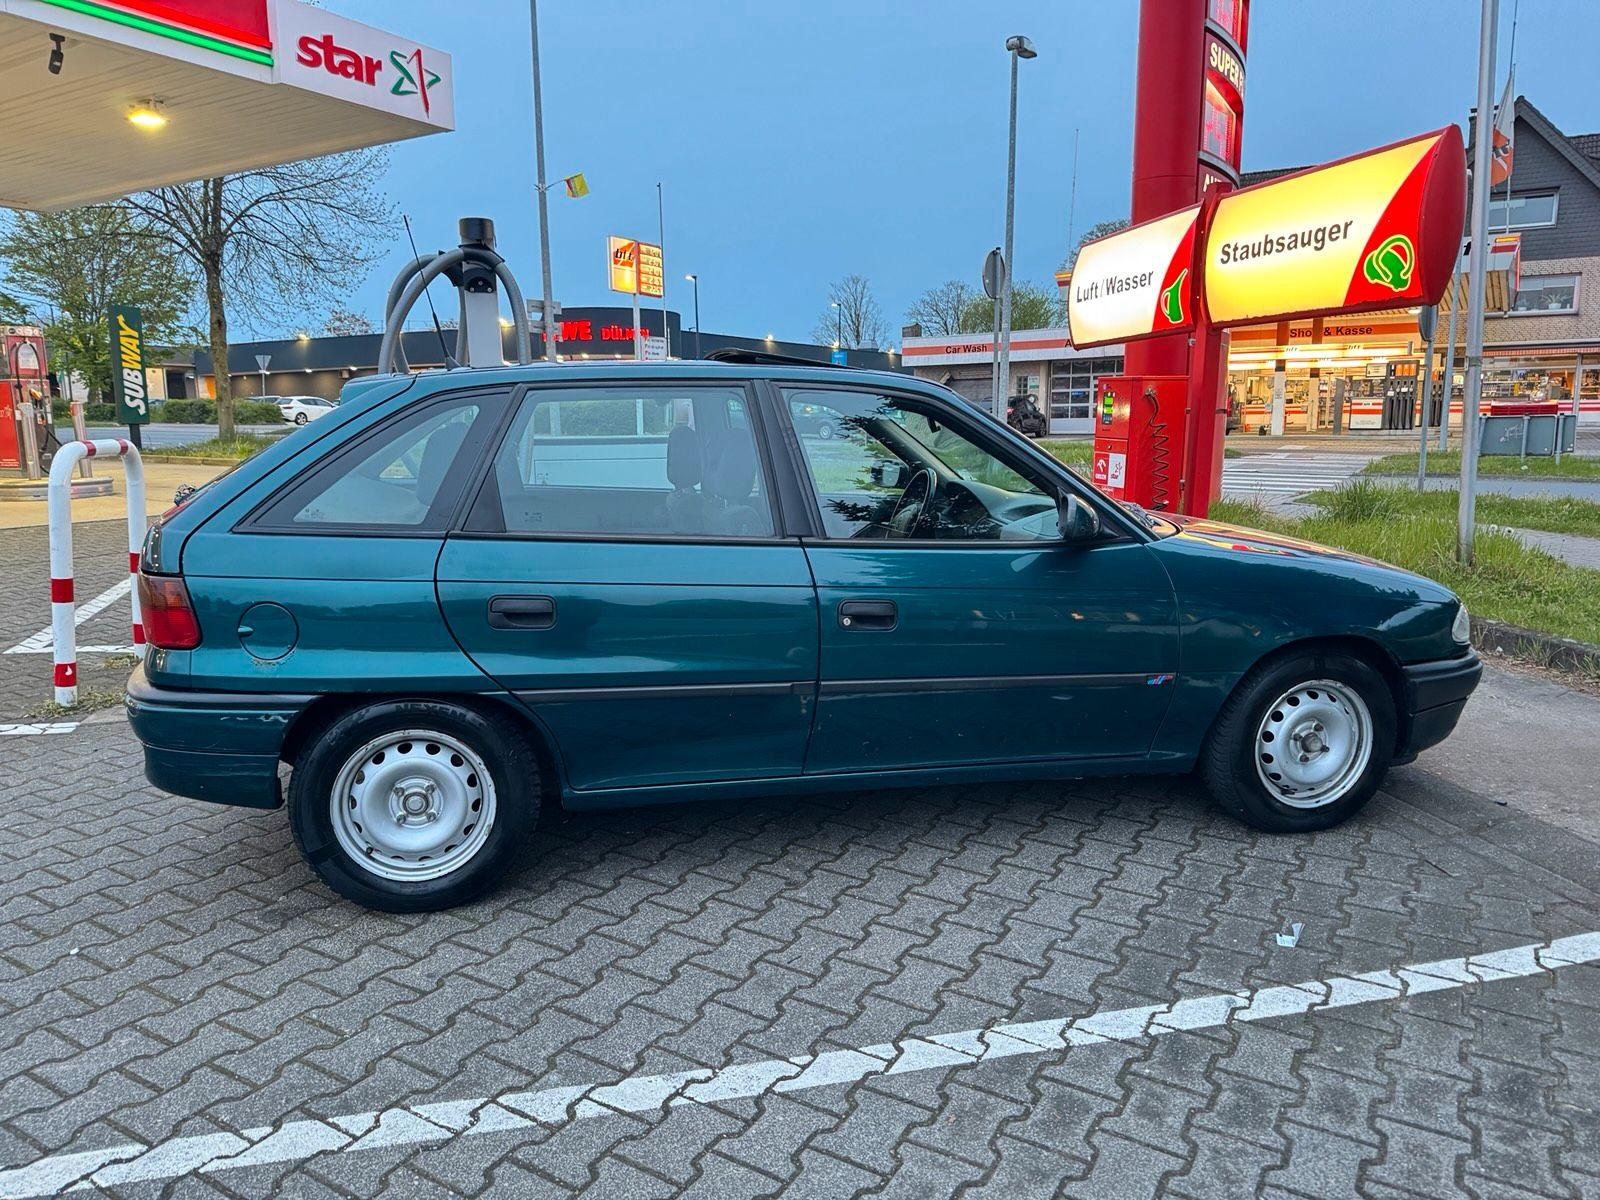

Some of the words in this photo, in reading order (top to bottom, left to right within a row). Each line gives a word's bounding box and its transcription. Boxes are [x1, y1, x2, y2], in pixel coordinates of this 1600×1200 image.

[296, 35, 382, 86] star
[1210, 42, 1239, 88] SUPER
[1220, 219, 1353, 265] Staubsauger
[945, 346, 960, 354] Car
[962, 344, 987, 353] Wash
[1064, 338, 1072, 348] A
[1290, 328, 1312, 338] Sho
[1323, 327, 1332, 336] &
[1336, 326, 1373, 336] Kasse
[117, 314, 146, 416] SUBWAY
[394, 703, 467, 720] NEXEN
